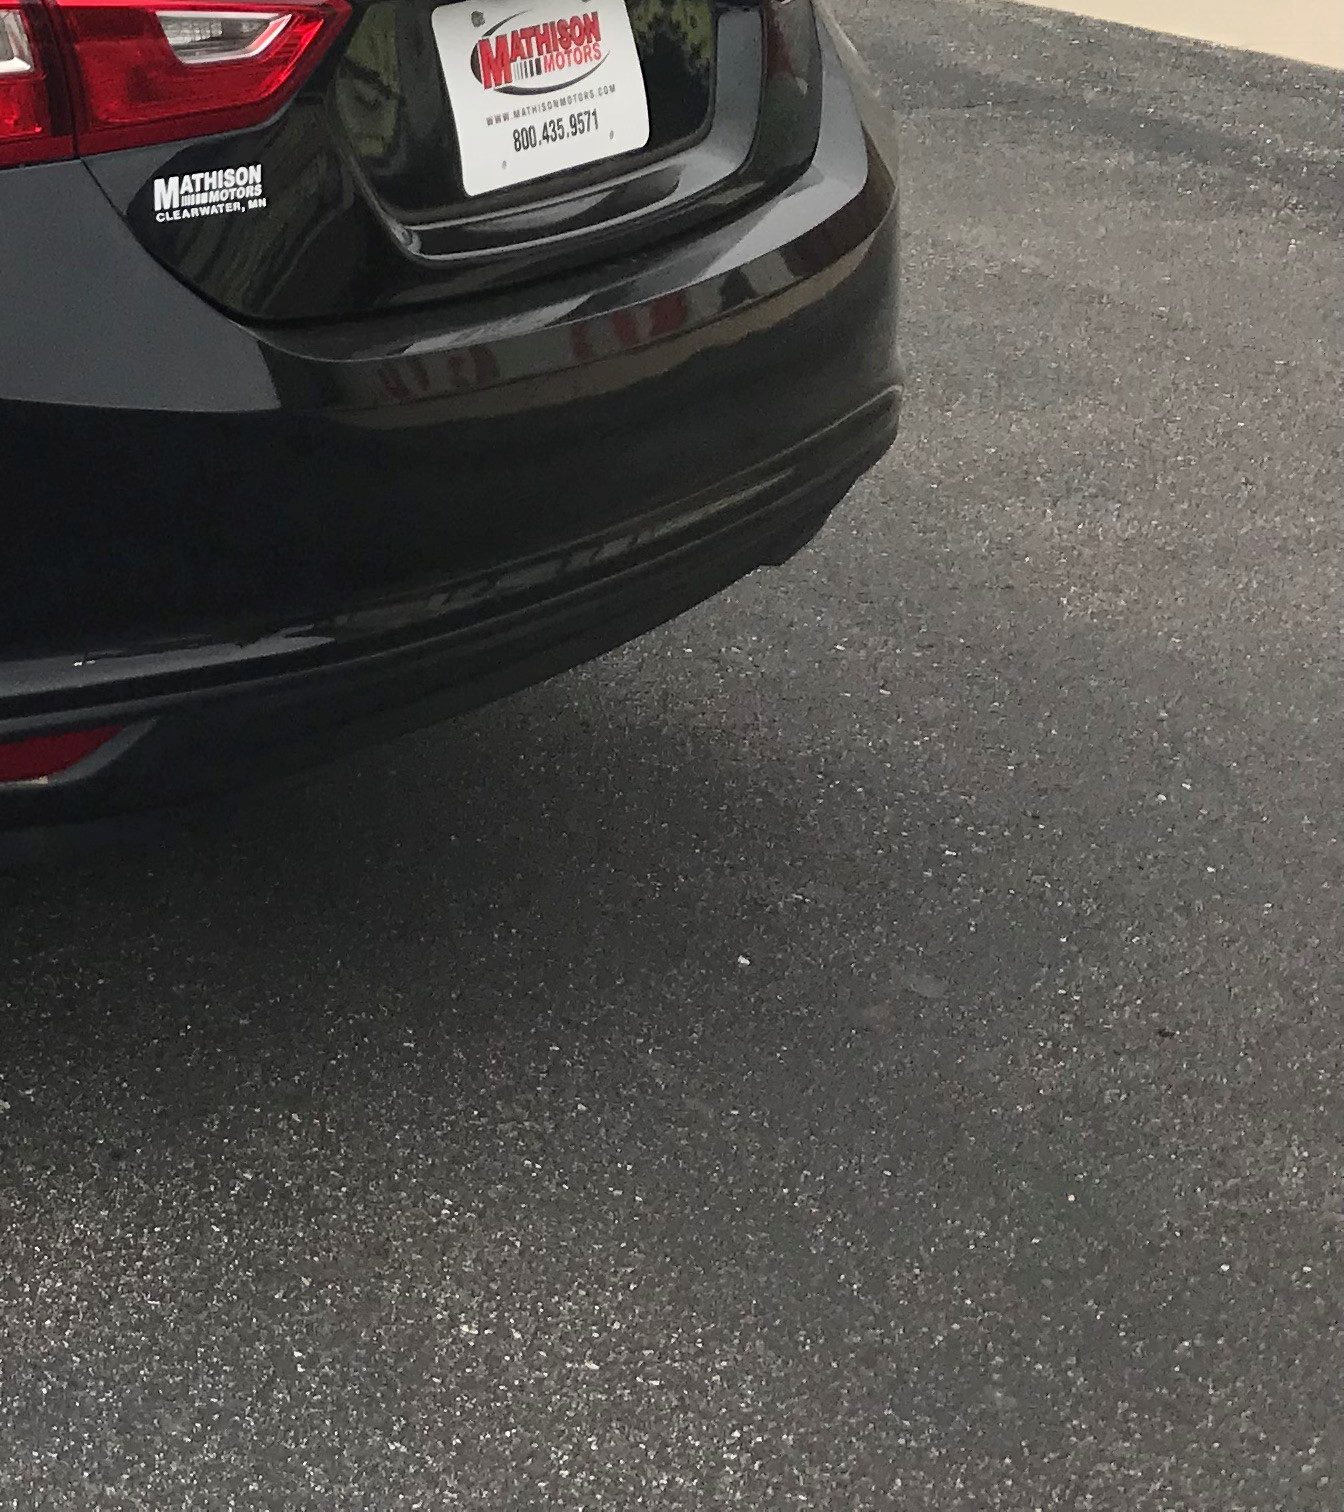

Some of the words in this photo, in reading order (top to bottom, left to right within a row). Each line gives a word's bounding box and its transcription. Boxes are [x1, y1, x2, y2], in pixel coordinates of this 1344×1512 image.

[478, 11, 601, 90] MATHISON
[543, 42, 602, 73] MOTORS
[513, 108, 598, 152] 800.435.9571
[154, 164, 262, 211] MATHISON
[208, 183, 263, 204] MOTORS
[155, 201, 247, 223] CLEARWATER,
[248, 197, 267, 210] MN
